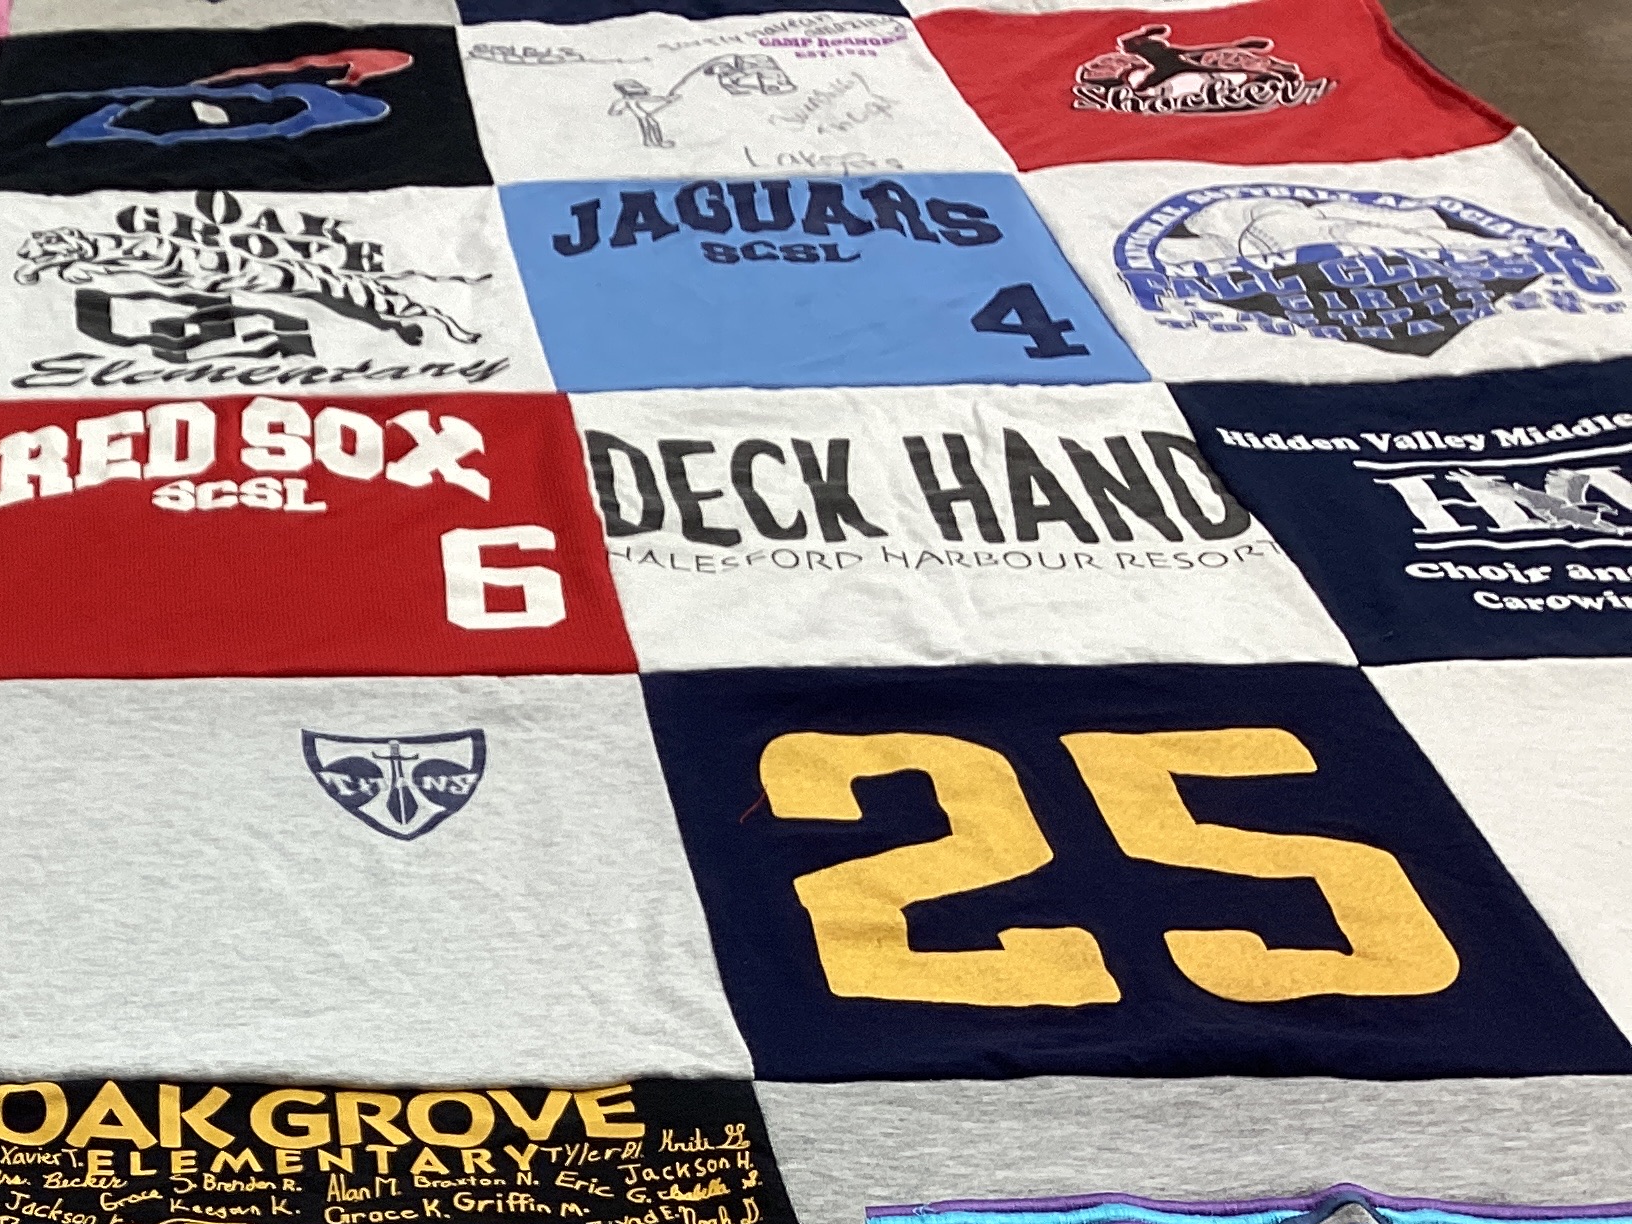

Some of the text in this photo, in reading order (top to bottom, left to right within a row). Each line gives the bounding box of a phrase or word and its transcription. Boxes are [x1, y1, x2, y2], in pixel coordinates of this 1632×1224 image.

[553, 180, 1003, 257] JAGUARS
[700, 240, 861, 264] SCSL
[1123, 268, 1308, 312] FALL
[971, 282, 1090, 359] 4
[11, 353, 509, 390] Elementary
[240, 396, 490, 501] SOX
[1216, 412, 1632, 453] Hidden Valley Middle
[151, 478, 327, 512] SCSL
[585, 428, 1252, 547] DECK HAND
[883, 546, 1101, 571] HARBOUR
[1117, 539, 1281, 570] RESORT
[1405, 560, 1632, 584] Choir an
[440, 525, 567, 629] 6
[759, 727, 1462, 1008] 25
[250, 1084, 646, 1150] GROVE
[0, 1146, 62, 1168] Xavier
[86, 1143, 538, 1177] ELEMENTARY
[617, 1157, 730, 1185] Jackson
[327, 1173, 371, 1202] Alan
[555, 1171, 615, 1197] Eric
[453, 1192, 551, 1215] Griffin
